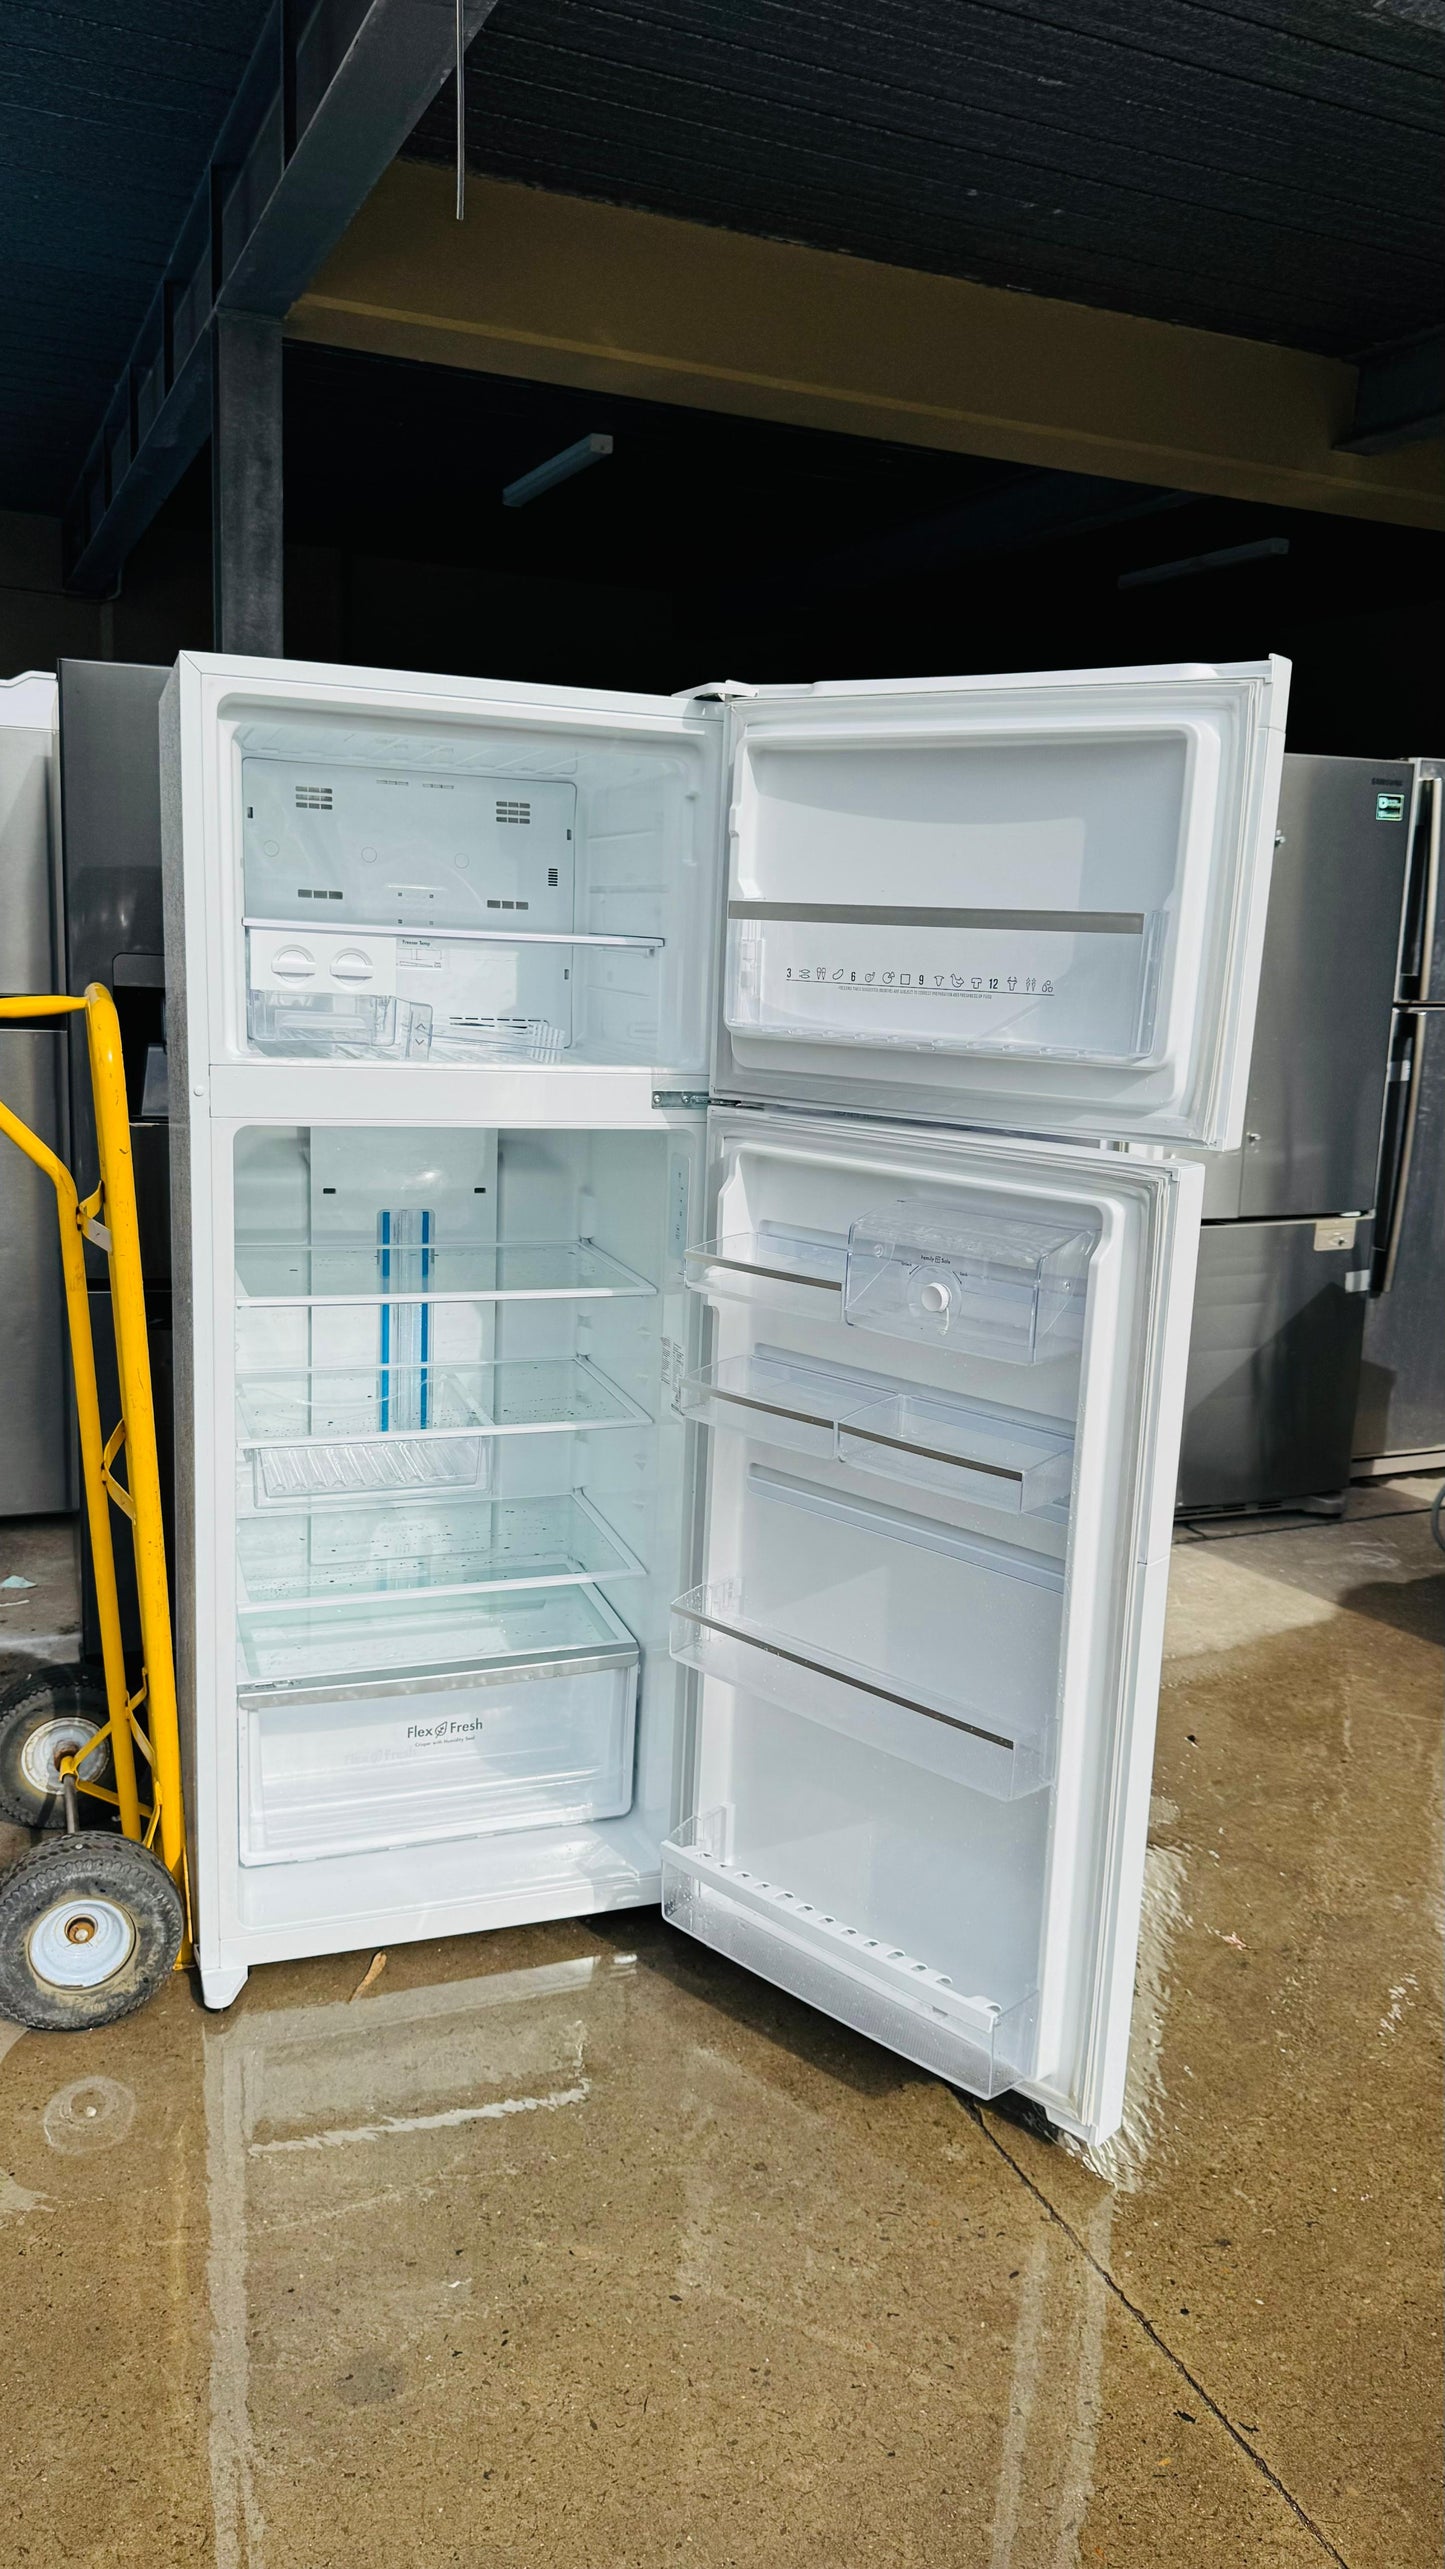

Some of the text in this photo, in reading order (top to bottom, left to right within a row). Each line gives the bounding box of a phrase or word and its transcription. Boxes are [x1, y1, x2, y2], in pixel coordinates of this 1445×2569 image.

[786, 968, 999, 990] 3 6 9 12
[407, 1717, 483, 1738] Flex Fresh
